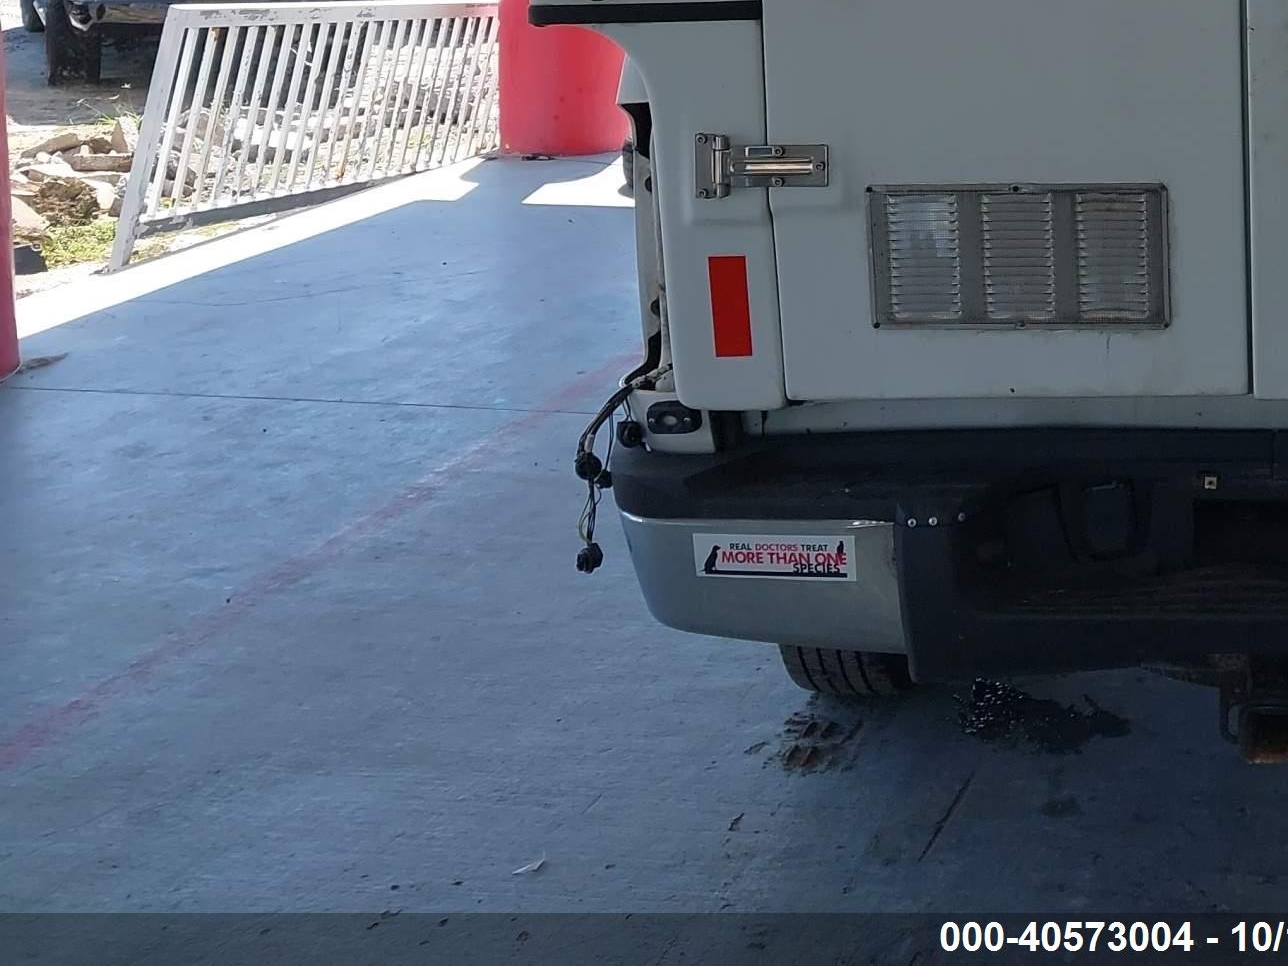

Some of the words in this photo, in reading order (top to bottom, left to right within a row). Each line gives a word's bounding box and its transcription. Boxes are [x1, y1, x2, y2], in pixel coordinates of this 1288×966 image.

[729, 543, 751, 551] REAL
[755, 543, 798, 552] DOCTORS
[801, 544, 829, 552] TREAT
[721, 551, 763, 564] MORE
[767, 552, 811, 565] THAN
[815, 553, 847, 566] ONE
[792, 563, 841, 574] SPECIES
